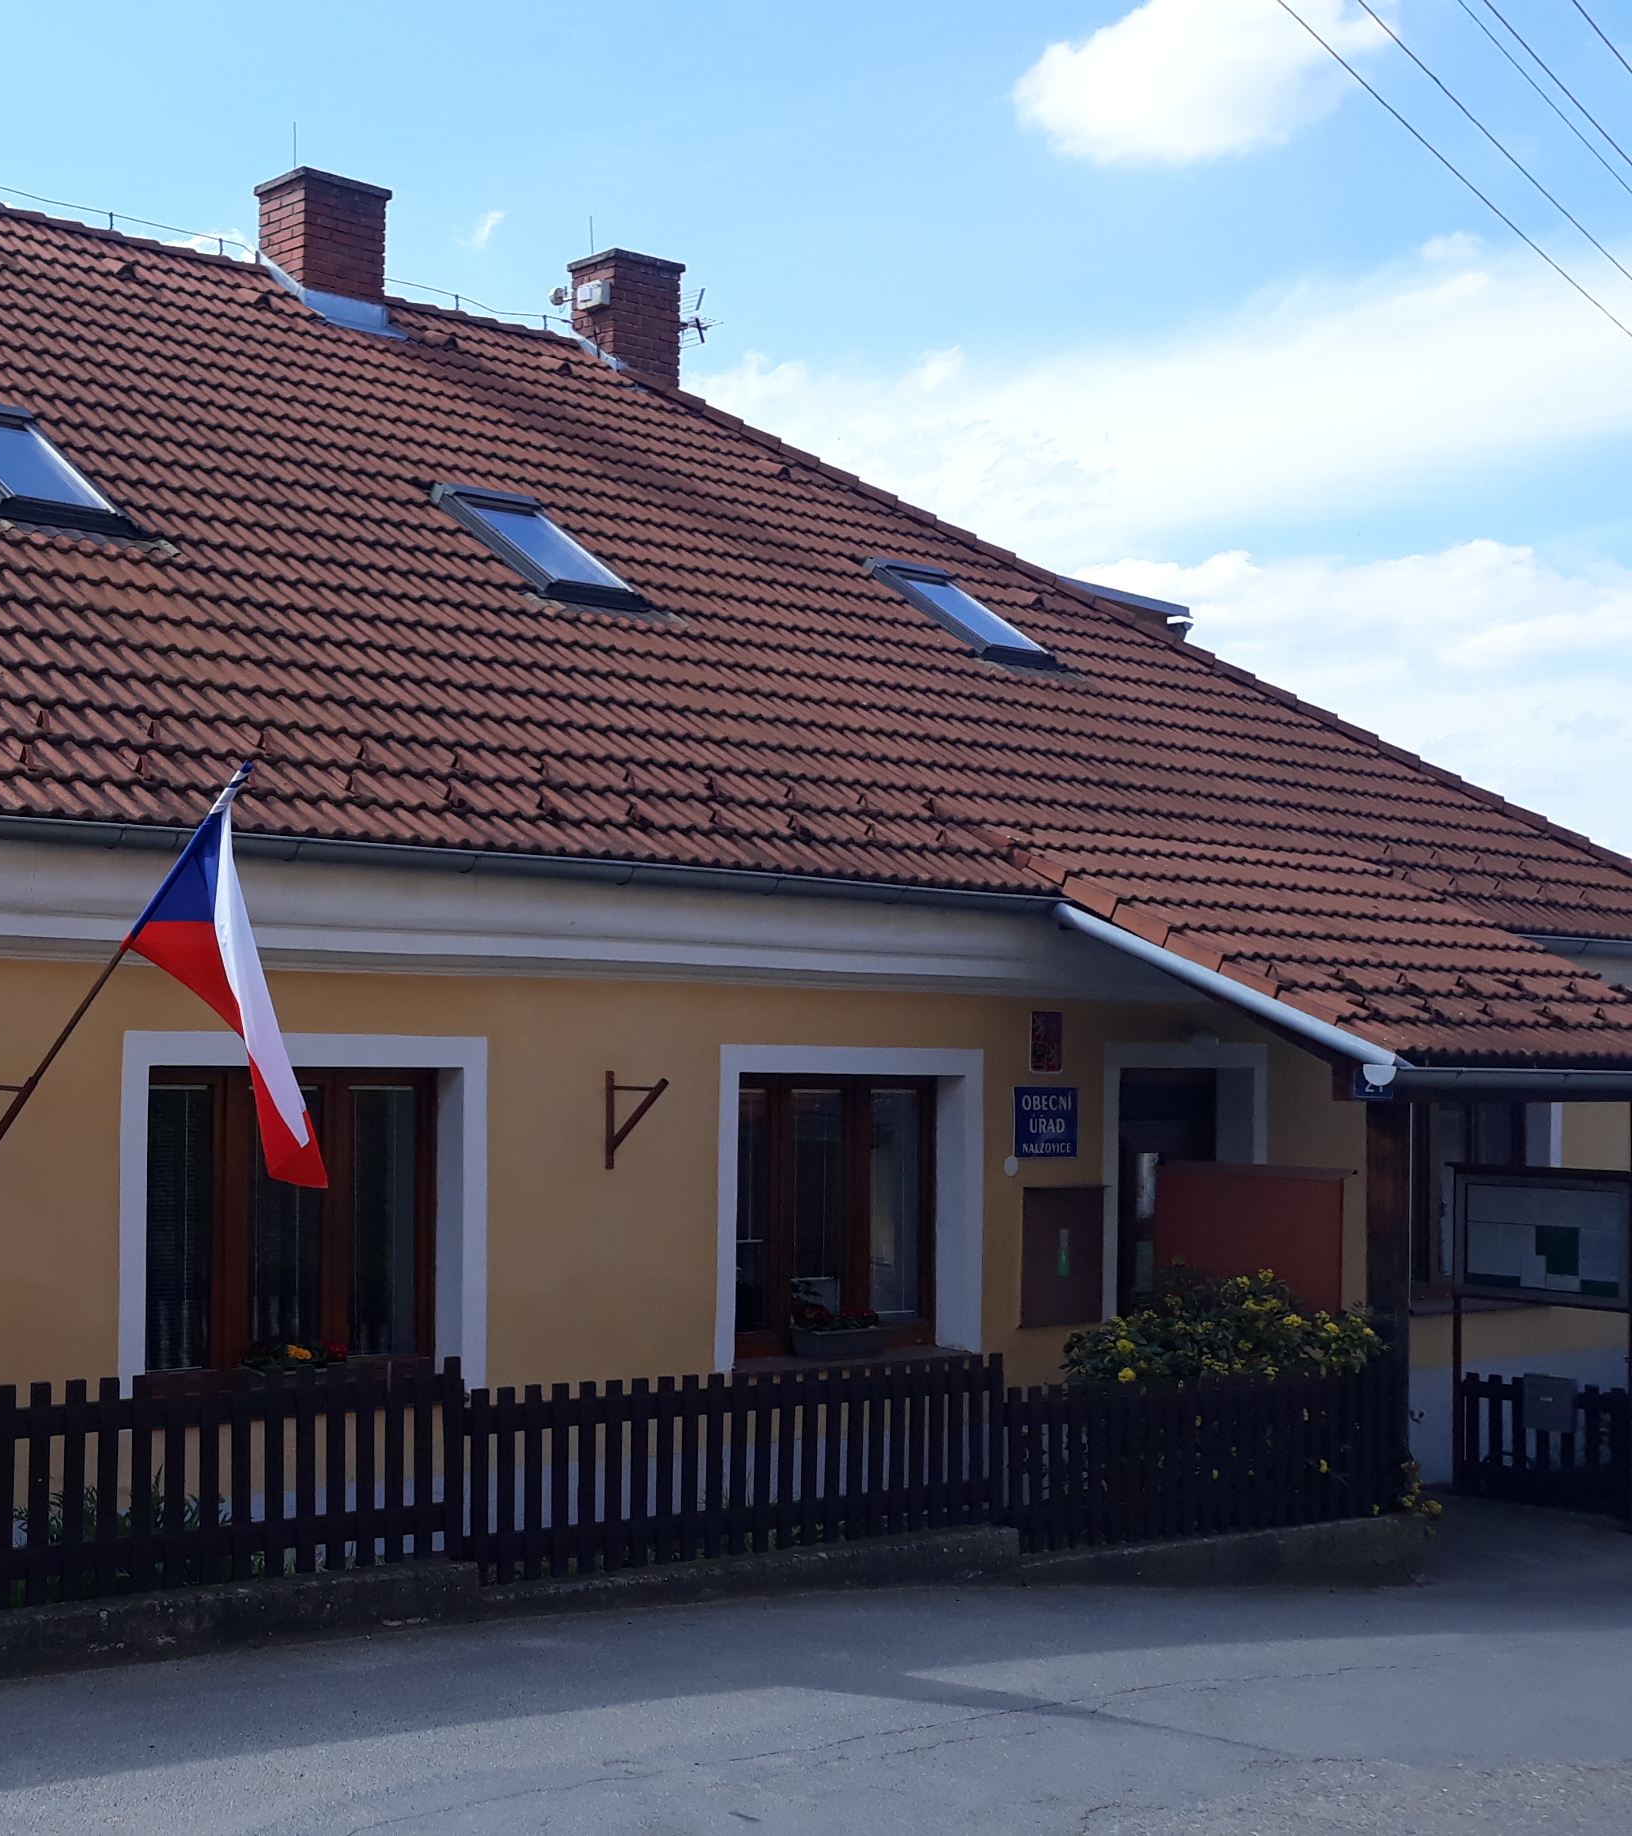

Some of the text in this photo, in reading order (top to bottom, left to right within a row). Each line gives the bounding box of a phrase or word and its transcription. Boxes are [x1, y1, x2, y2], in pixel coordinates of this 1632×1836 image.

[1021, 1091, 1072, 1111] OBECNÍ
[1029, 1112, 1066, 1134] ÚŘAD
[1022, 1140, 1072, 1154] NALŽOVICE
